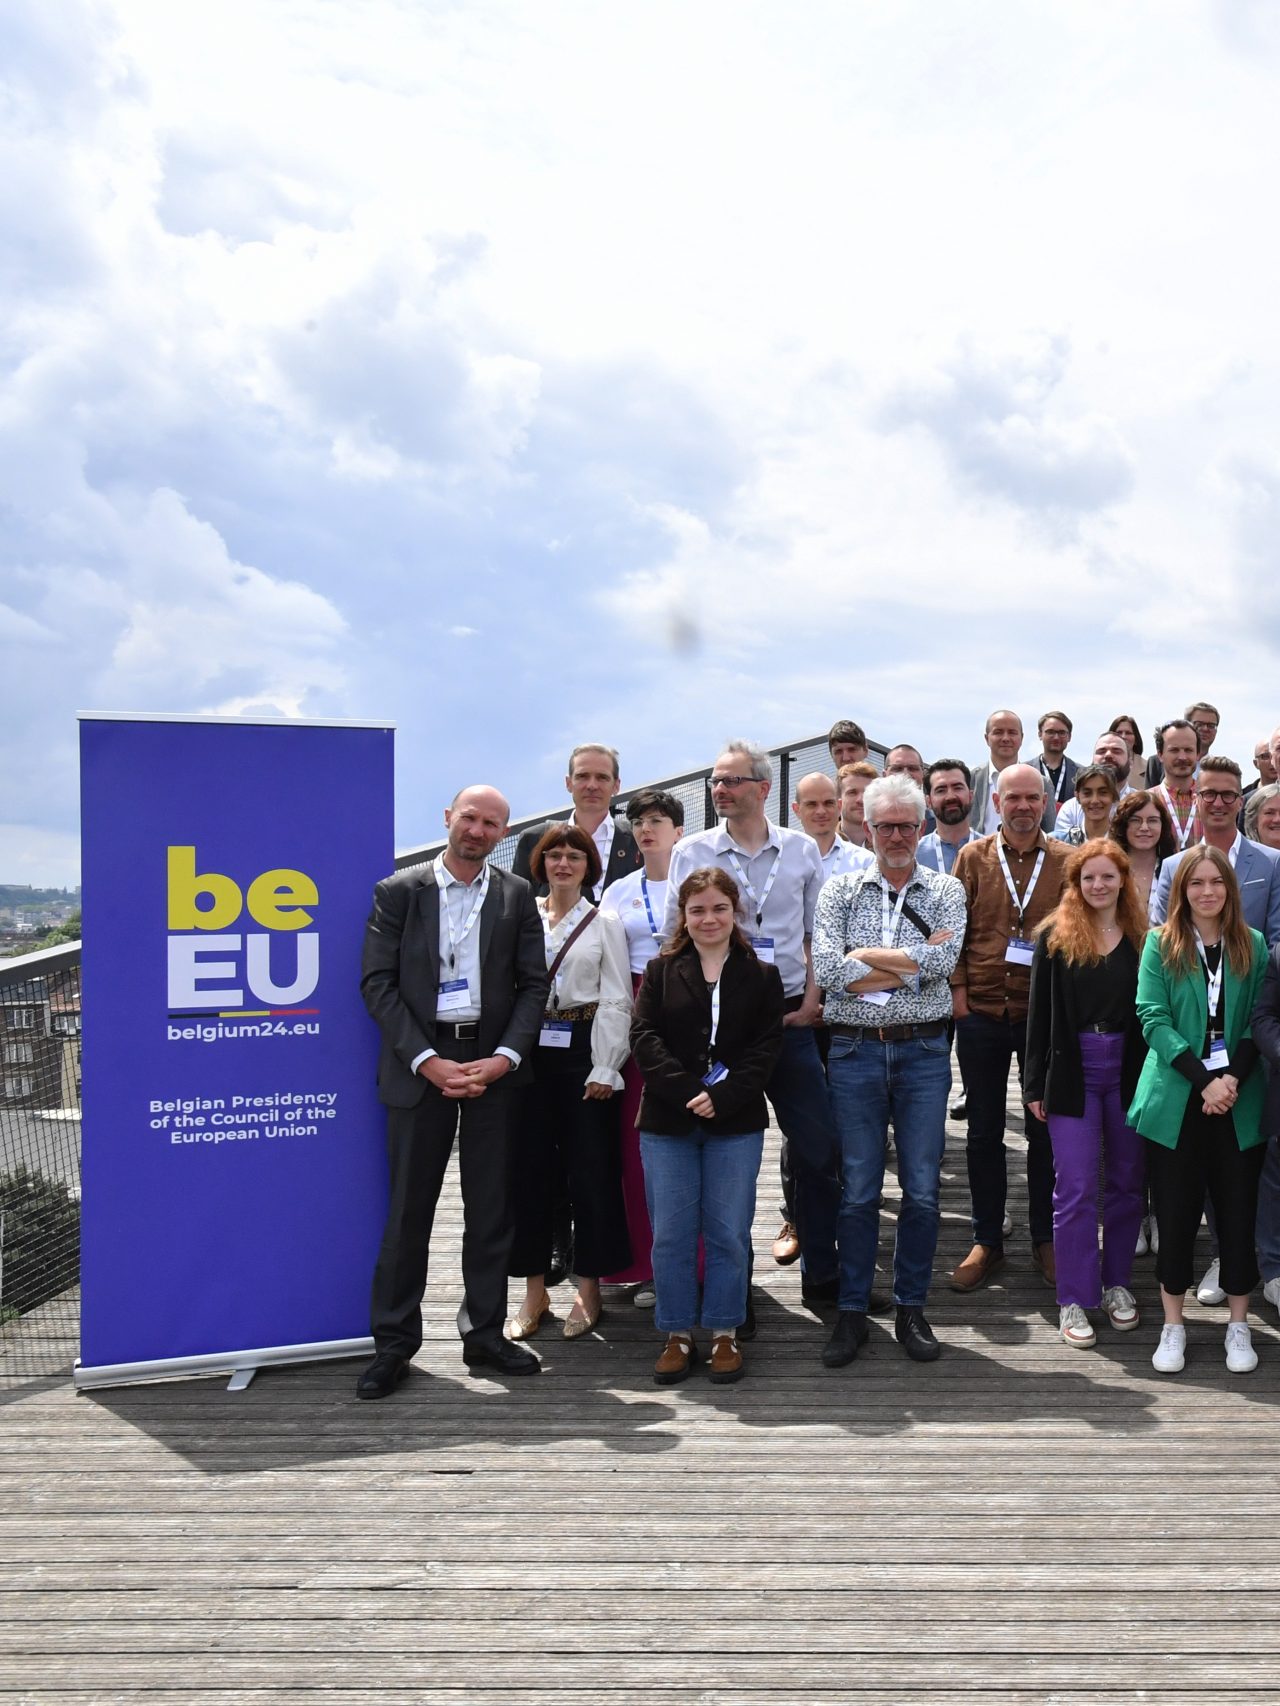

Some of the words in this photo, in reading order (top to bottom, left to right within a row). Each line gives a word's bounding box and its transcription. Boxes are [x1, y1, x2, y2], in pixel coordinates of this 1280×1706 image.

[167, 845, 319, 931] be
[167, 932, 320, 1009] EU
[167, 1021, 320, 1042] belgium24.eu
[149, 1097, 226, 1114] Belgian
[232, 1092, 338, 1109] Presidency
[150, 1115, 171, 1129] of
[174, 1114, 206, 1128] the
[211, 1108, 280, 1126] Council
[284, 1107, 303, 1121] of
[306, 1107, 337, 1120] the
[171, 1128, 260, 1145] European
[265, 1123, 318, 1138] Union
